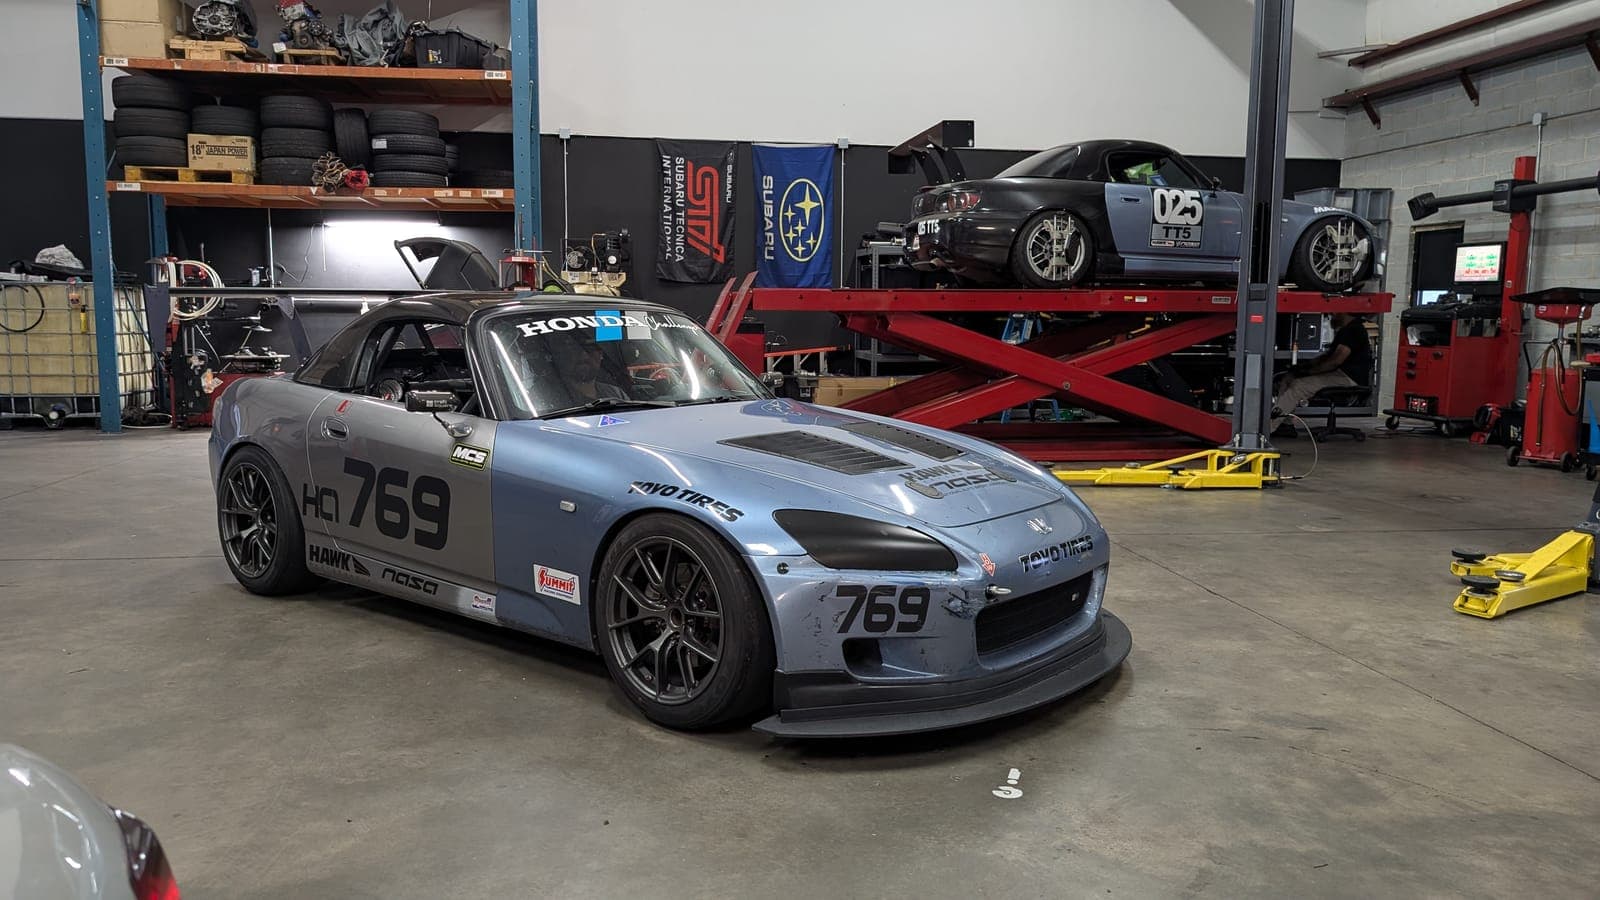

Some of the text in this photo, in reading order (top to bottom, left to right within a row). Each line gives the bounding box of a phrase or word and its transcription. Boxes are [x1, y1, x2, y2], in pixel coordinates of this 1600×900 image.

[190, 144, 248, 156] 18" JAPAN POWER
[726, 164, 734, 203] SUBARU
[662, 154, 672, 261] INTERNATIONAL
[675, 156, 685, 263] SUBARU TECNICA
[762, 175, 775, 262] SUBARU
[1153, 189, 1203, 225] 025
[1162, 226, 1192, 239] TT5
[516, 315, 649, 337] HONDA
[453, 445, 488, 464] MCS
[343, 457, 450, 551] 769
[628, 480, 745, 523] TOYO TIRES
[309, 544, 351, 572] HAWK
[1019, 544, 1060, 573] TOYO
[1059, 535, 1094, 559] TIRES
[836, 585, 931, 634] 769
